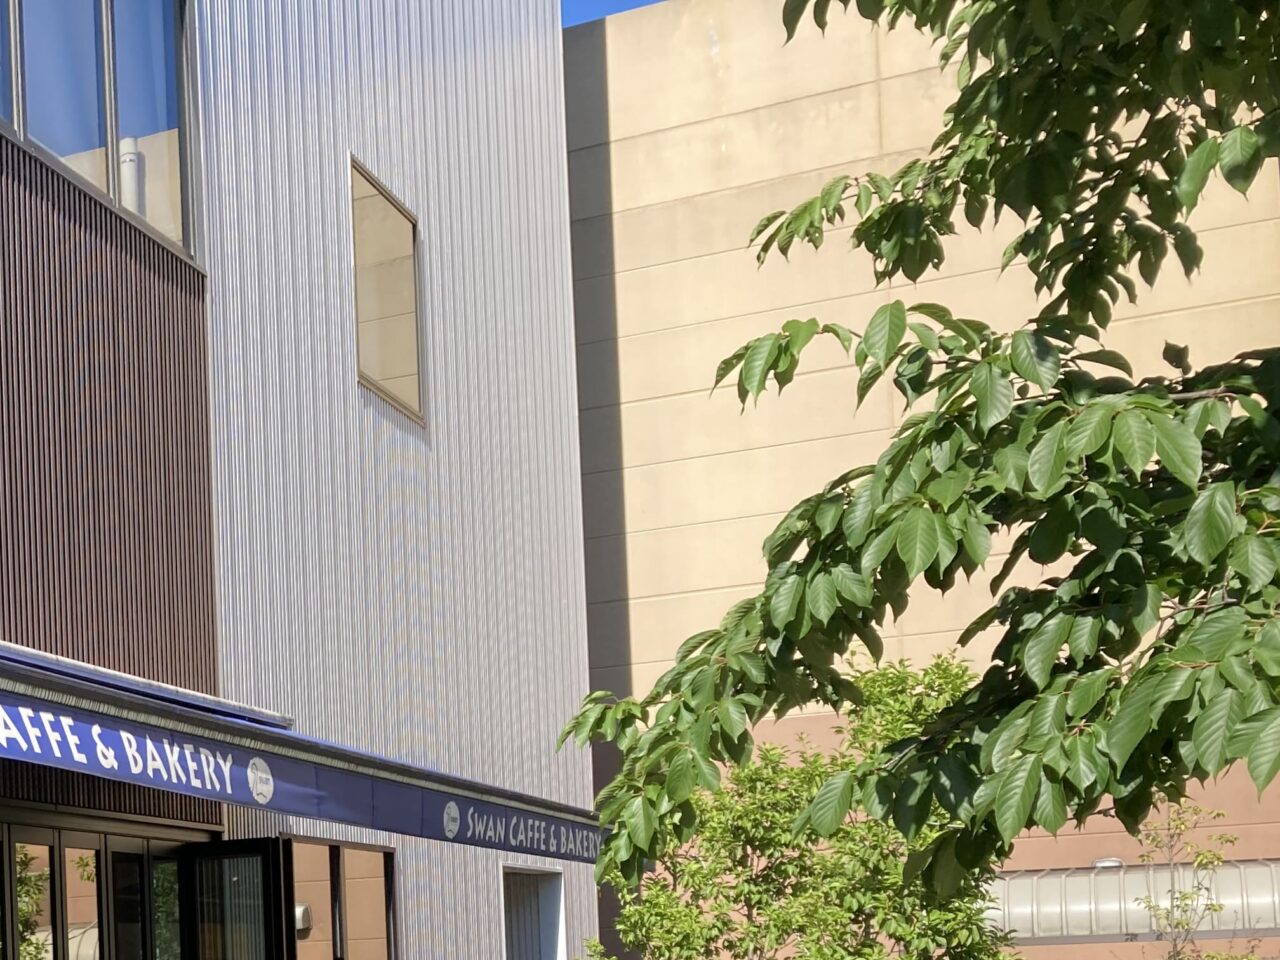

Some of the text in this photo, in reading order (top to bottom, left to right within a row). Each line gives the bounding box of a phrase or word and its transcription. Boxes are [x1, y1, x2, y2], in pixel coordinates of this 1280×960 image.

[91, 723, 119, 771] &
[120, 730, 233, 795] BAKERY
[466, 806, 602, 859] SWAN CAFFE & BAKERY
